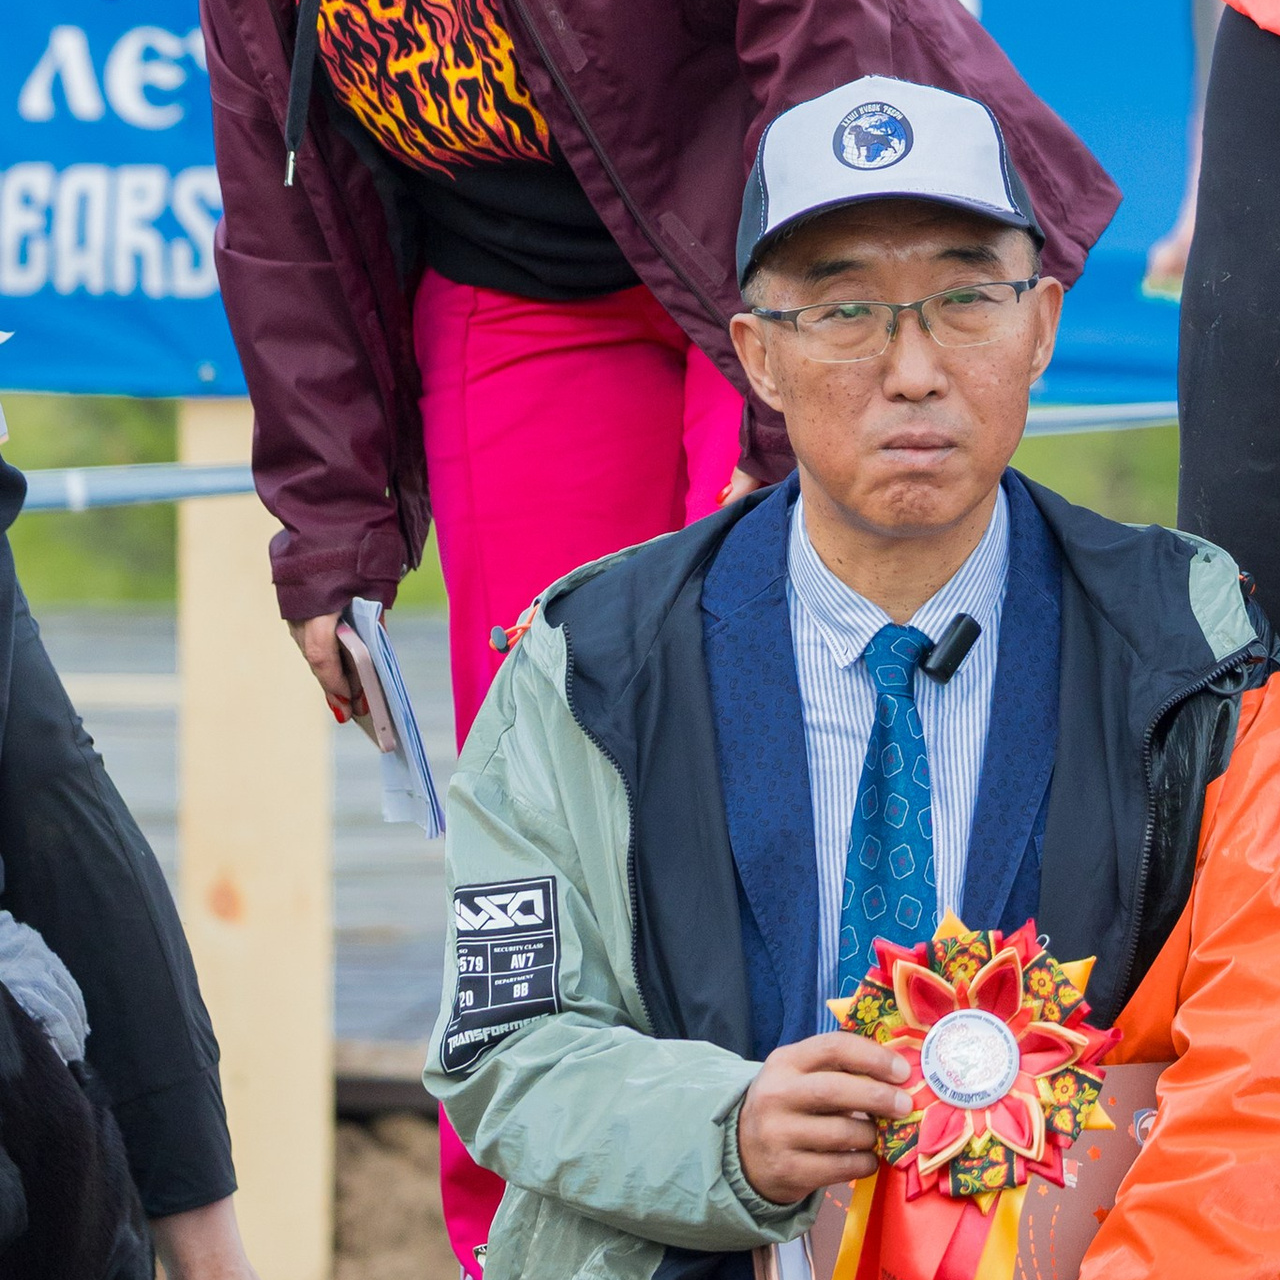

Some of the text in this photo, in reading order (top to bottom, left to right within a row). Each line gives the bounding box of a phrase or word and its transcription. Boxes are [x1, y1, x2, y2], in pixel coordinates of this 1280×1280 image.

[18, 24, 208, 131] ЛЕ
[524, 943, 544, 951] CLASS
[510, 952, 535, 970] AV7
[495, 973, 534, 986] DEPARTMENT
[513, 982, 529, 999] BB
